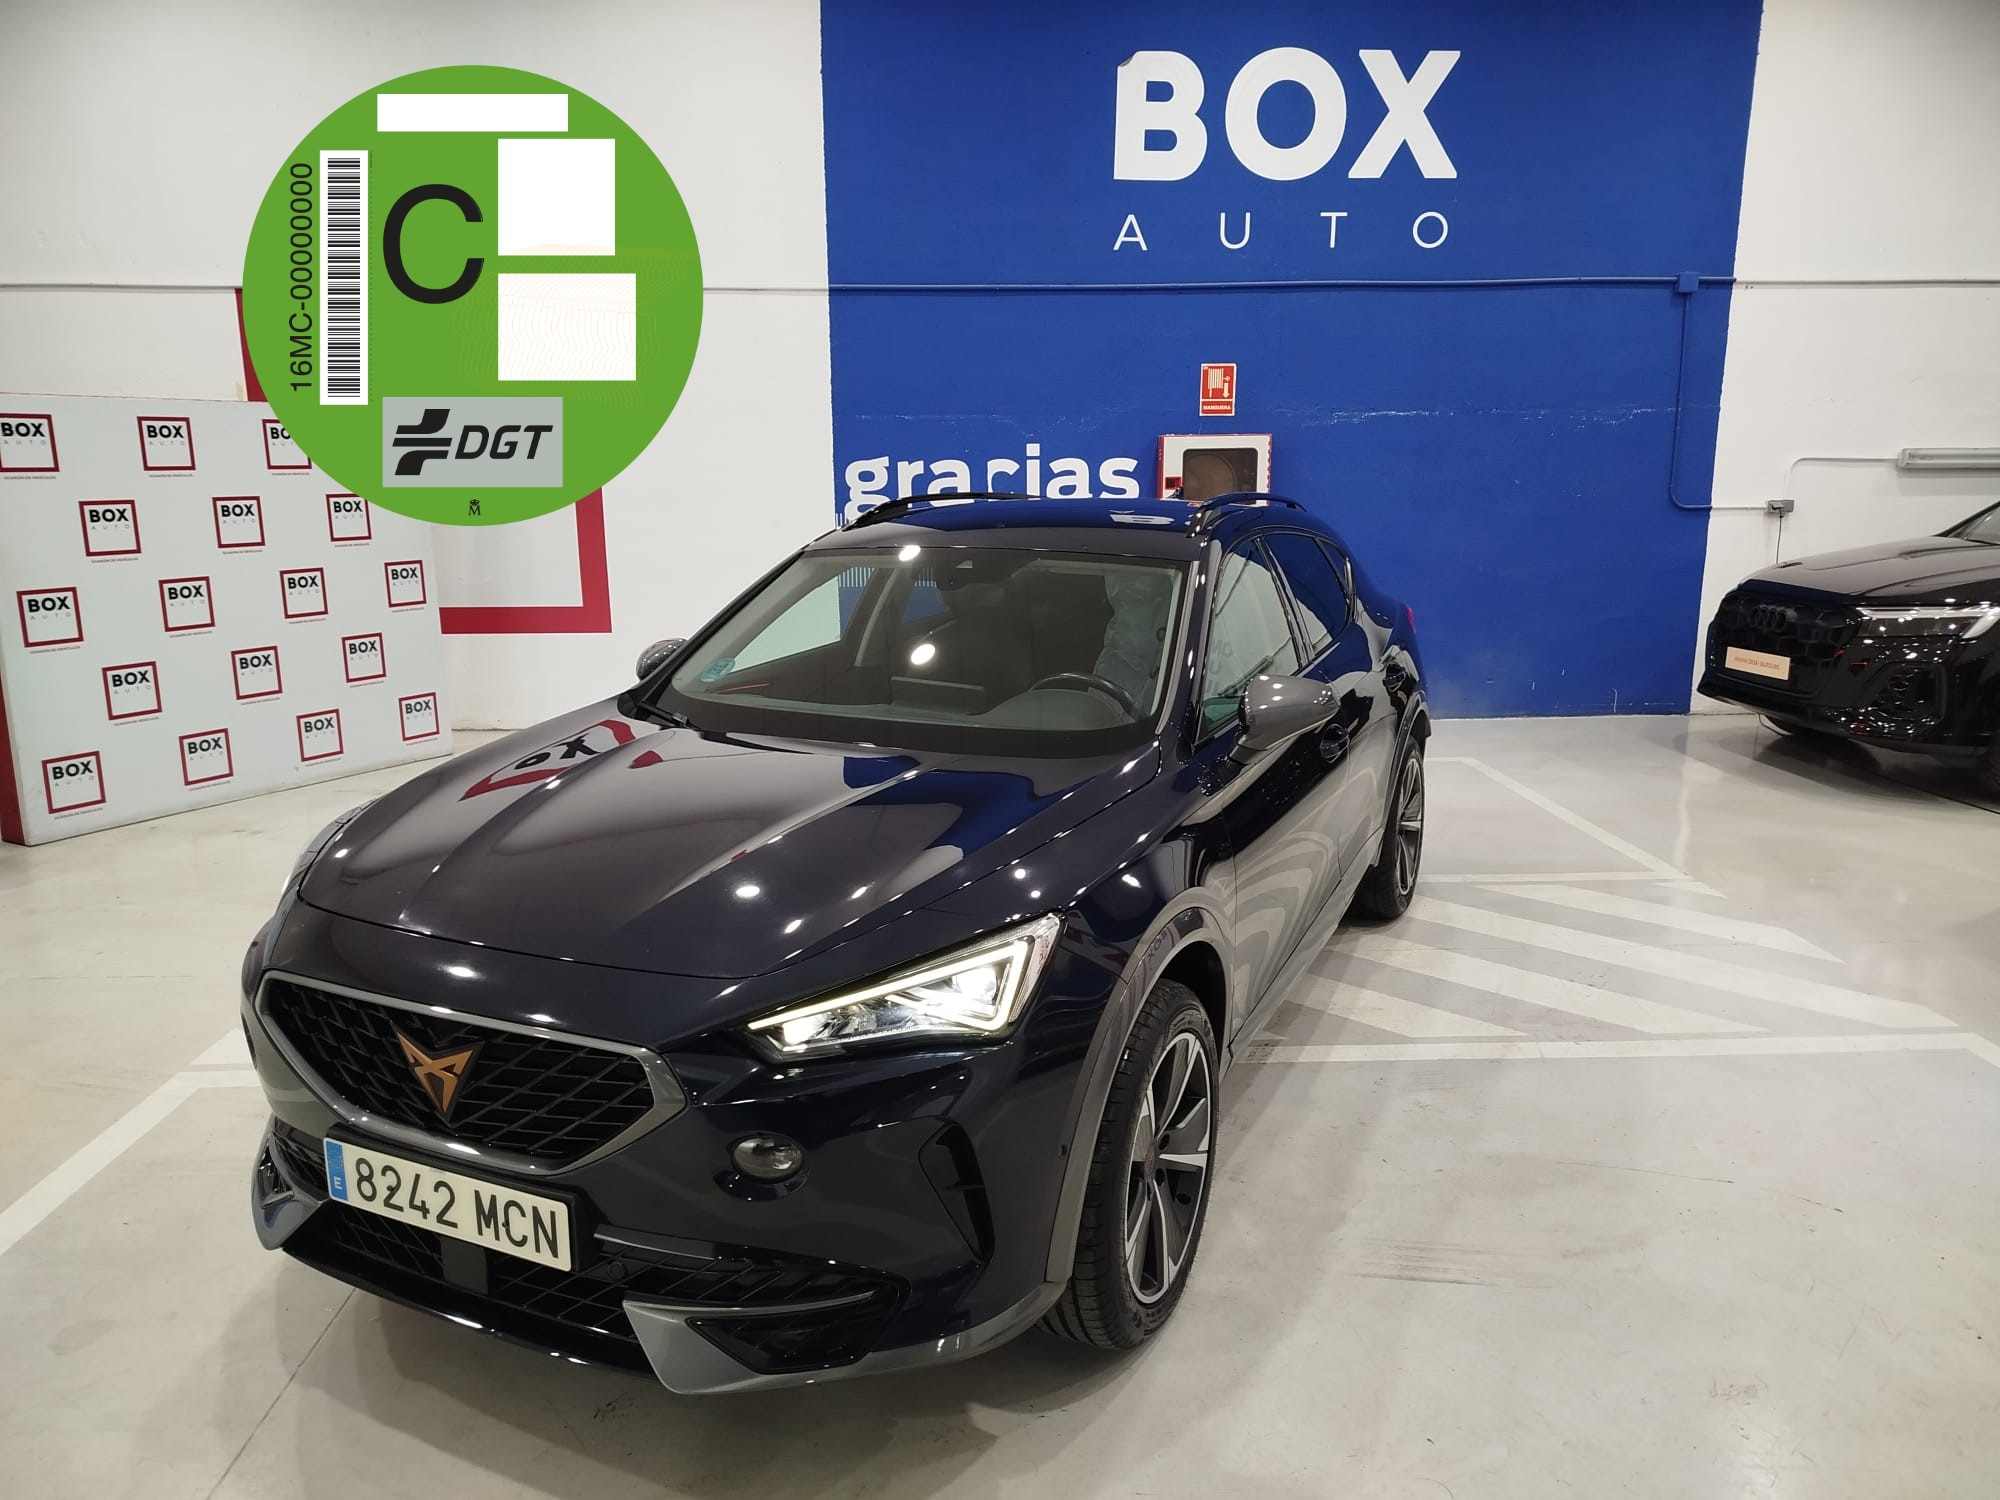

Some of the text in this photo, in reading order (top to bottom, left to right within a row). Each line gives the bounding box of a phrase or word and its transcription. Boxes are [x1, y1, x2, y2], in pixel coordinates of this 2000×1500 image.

[1113, 47, 1461, 181] BOX
[1113, 211, 1449, 251] AUTO
[1, 422, 46, 437] BOX
[146, 425, 184, 438] BOX
[270, 427, 291, 440] BO
[844, 443, 1140, 524] gracias
[221, 504, 255, 517] BOX
[333, 501, 363, 513] BOX
[88, 508, 129, 523] BOX
[391, 567, 419, 580] BOX
[287, 575, 319, 589] BOX
[168, 585, 204, 600] BOX
[27, 596, 71, 613] BOX
[349, 640, 378, 654] BOX
[239, 654, 272, 669] BOX
[111, 670, 151, 687] BOX
[405, 700, 432, 714] BOX
[304, 717, 335, 732] BOX
[188, 737, 223, 754] BOX
[52, 760, 94, 780] BOX
[334, 1175, 343, 1190] E
[355, 1157, 559, 1259] 8242 MCN
